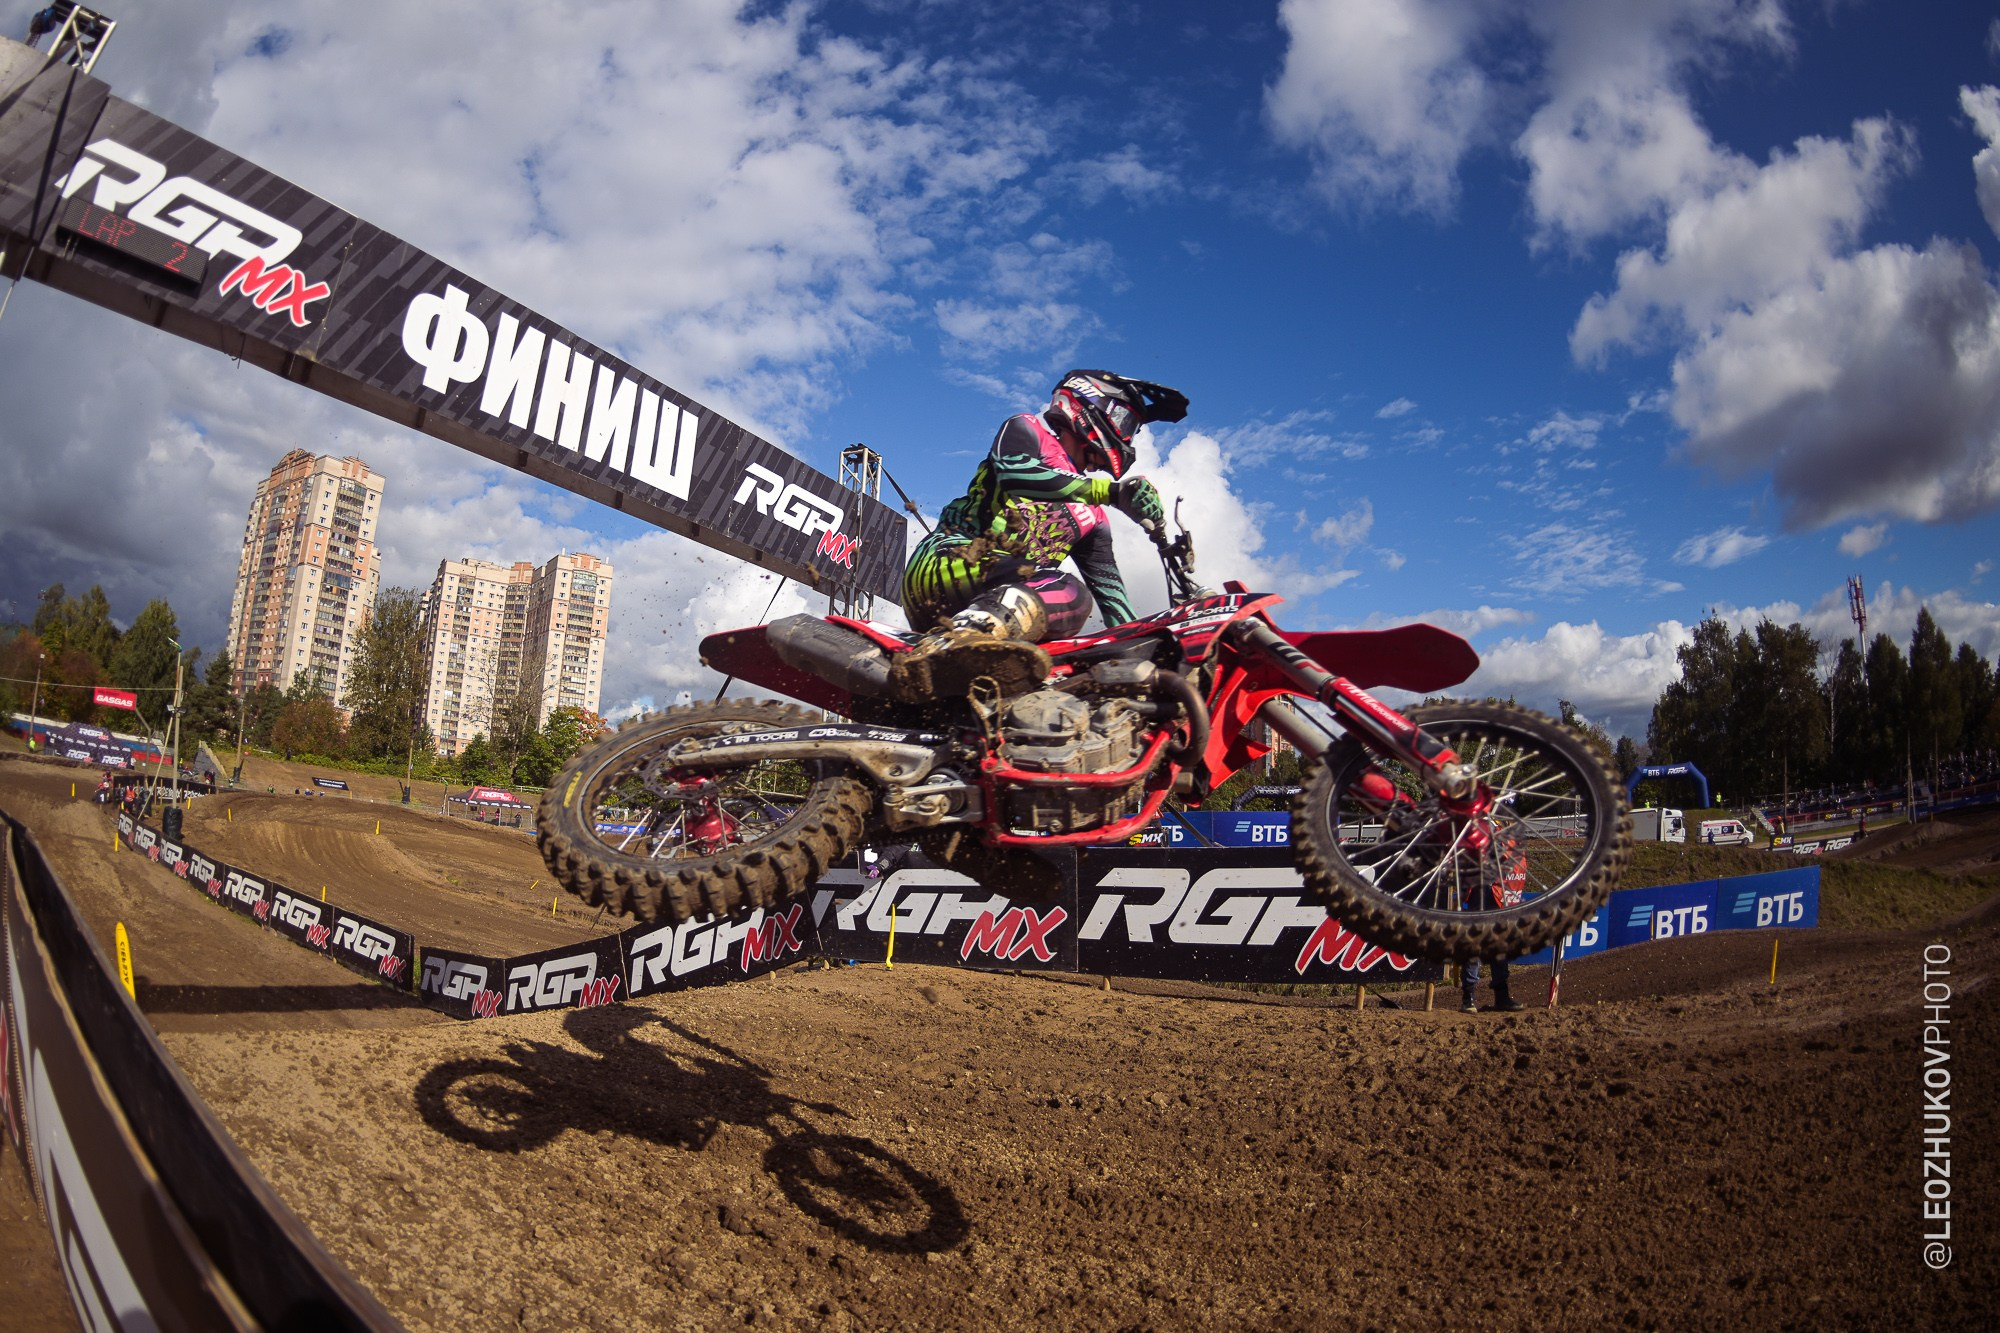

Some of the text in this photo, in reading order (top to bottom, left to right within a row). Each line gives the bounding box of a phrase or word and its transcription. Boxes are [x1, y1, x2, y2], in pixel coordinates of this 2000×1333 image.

[54, 139, 331, 327] RGP MX
[78, 206, 188, 273] LAP 2
[402, 284, 698, 501] ФИНИШ
[733, 462, 862, 569] RGP MX
[96, 694, 134, 707] GASGAS
[79, 727, 104, 738] RGP
[67, 749, 91, 760] RGP
[102, 755, 125, 765] RGP
[1647, 769, 1660, 777] ВТБ
[134, 825, 156, 850] RGP
[1129, 833, 1164, 846] SMX
[1252, 825, 1288, 842] ВТБ
[1773, 837, 1792, 846] SMX
[1793, 842, 1820, 854] RGP
[1825, 838, 1851, 851] RGP
[160, 838, 183, 866] RGP
[190, 853, 216, 883] RGP
[224, 872, 270, 921] RGP MX
[1757, 891, 1804, 927] ВТБ
[271, 891, 331, 949] RGP MX
[961, 906, 1067, 961] MX
[1655, 905, 1708, 940] ВТБ
[333, 916, 407, 983] RGP MX
[741, 903, 803, 973] MX
[420, 956, 503, 1019] RGP MX
[507, 951, 620, 1011] RGP MX
